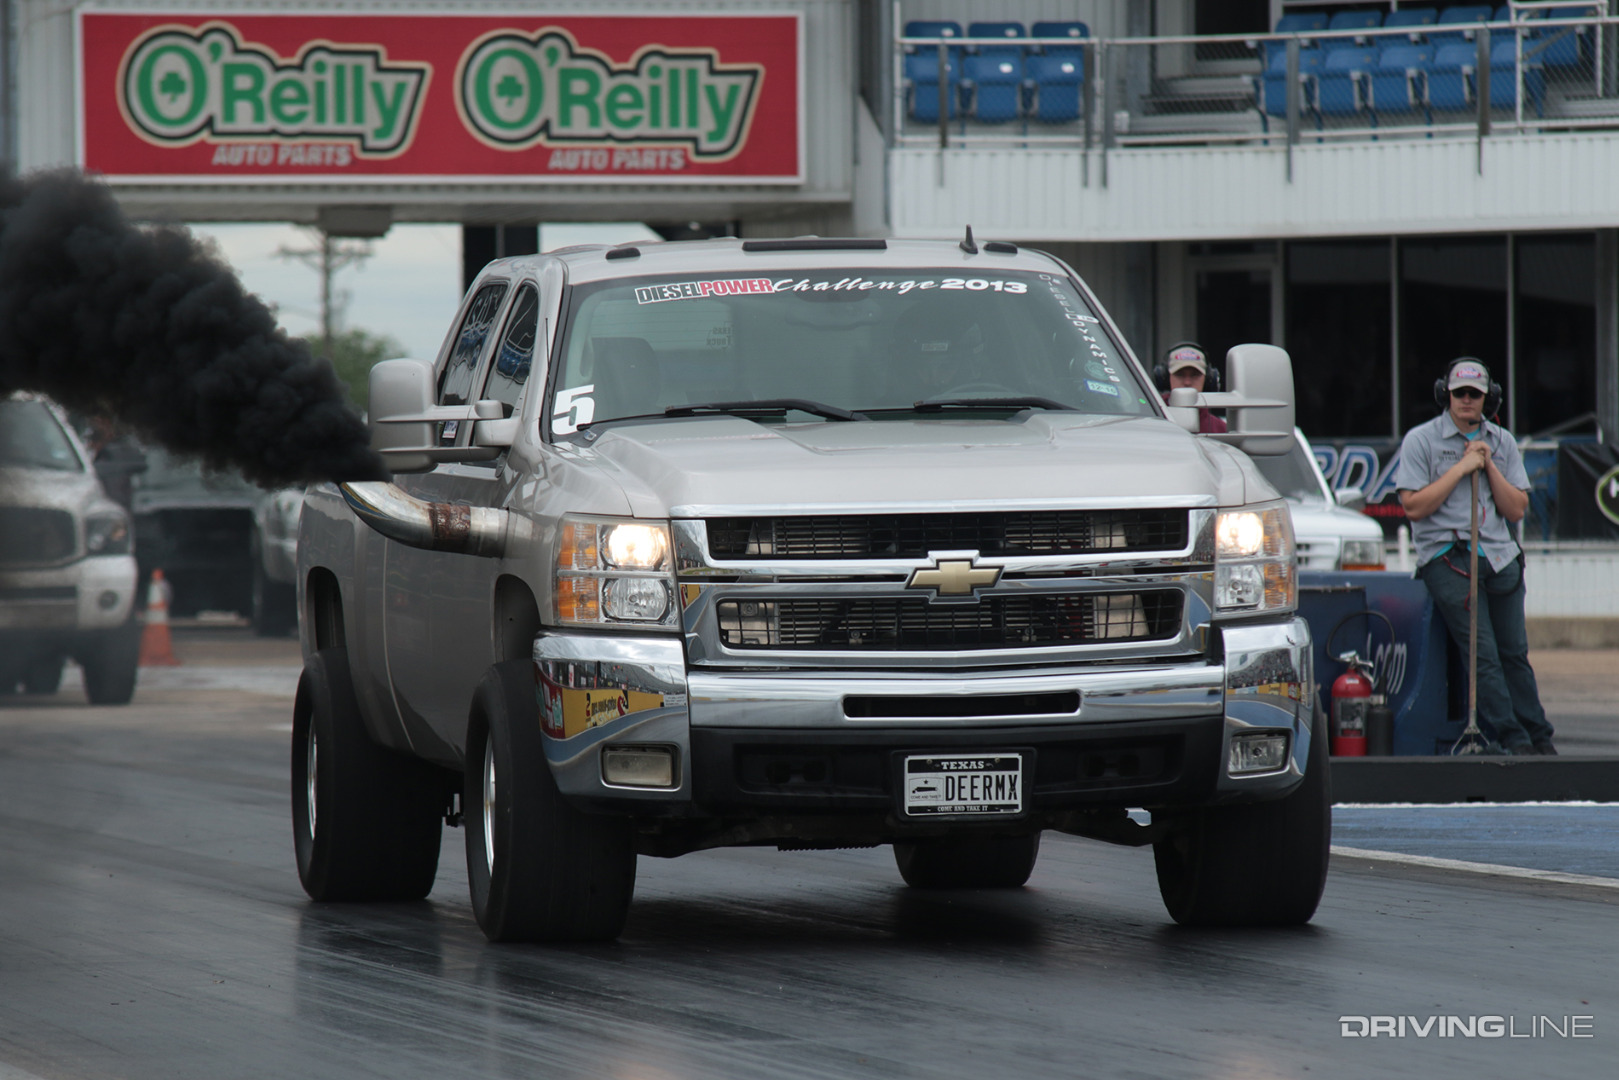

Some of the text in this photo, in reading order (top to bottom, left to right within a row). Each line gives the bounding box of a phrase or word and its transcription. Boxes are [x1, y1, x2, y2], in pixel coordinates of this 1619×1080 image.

[136, 42, 409, 140] O'Reilly
[474, 46, 743, 143] O'Reilly
[211, 145, 352, 167] AUTO PARTS
[547, 149, 686, 170] AUTO PARTS
[772, 277, 940, 295] Challenge
[940, 278, 1028, 294] 2013
[551, 384, 595, 436] 5
[940, 761, 985, 770] TEXAS
[945, 774, 1018, 801] DEERMX
